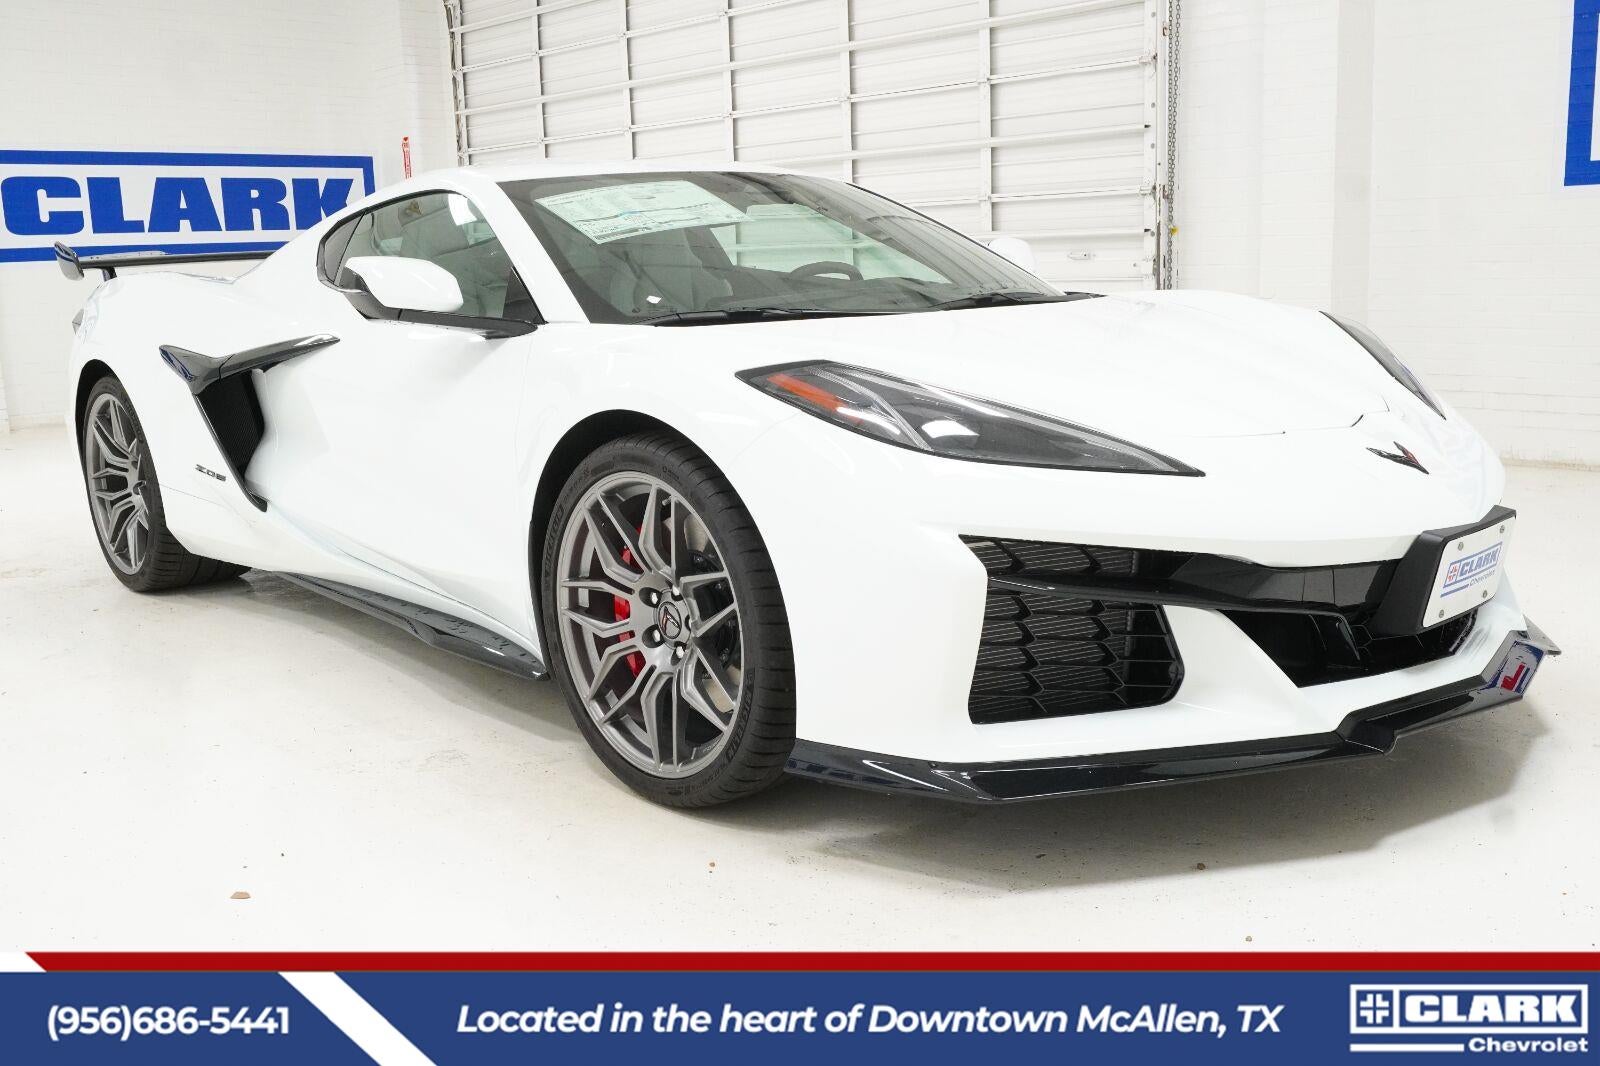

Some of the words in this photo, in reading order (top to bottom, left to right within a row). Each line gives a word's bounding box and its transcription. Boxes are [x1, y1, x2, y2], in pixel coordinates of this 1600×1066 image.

[1, 176, 355, 236] CLARK
[195, 464, 227, 482] Z06
[1459, 548, 1499, 577] CLARK
